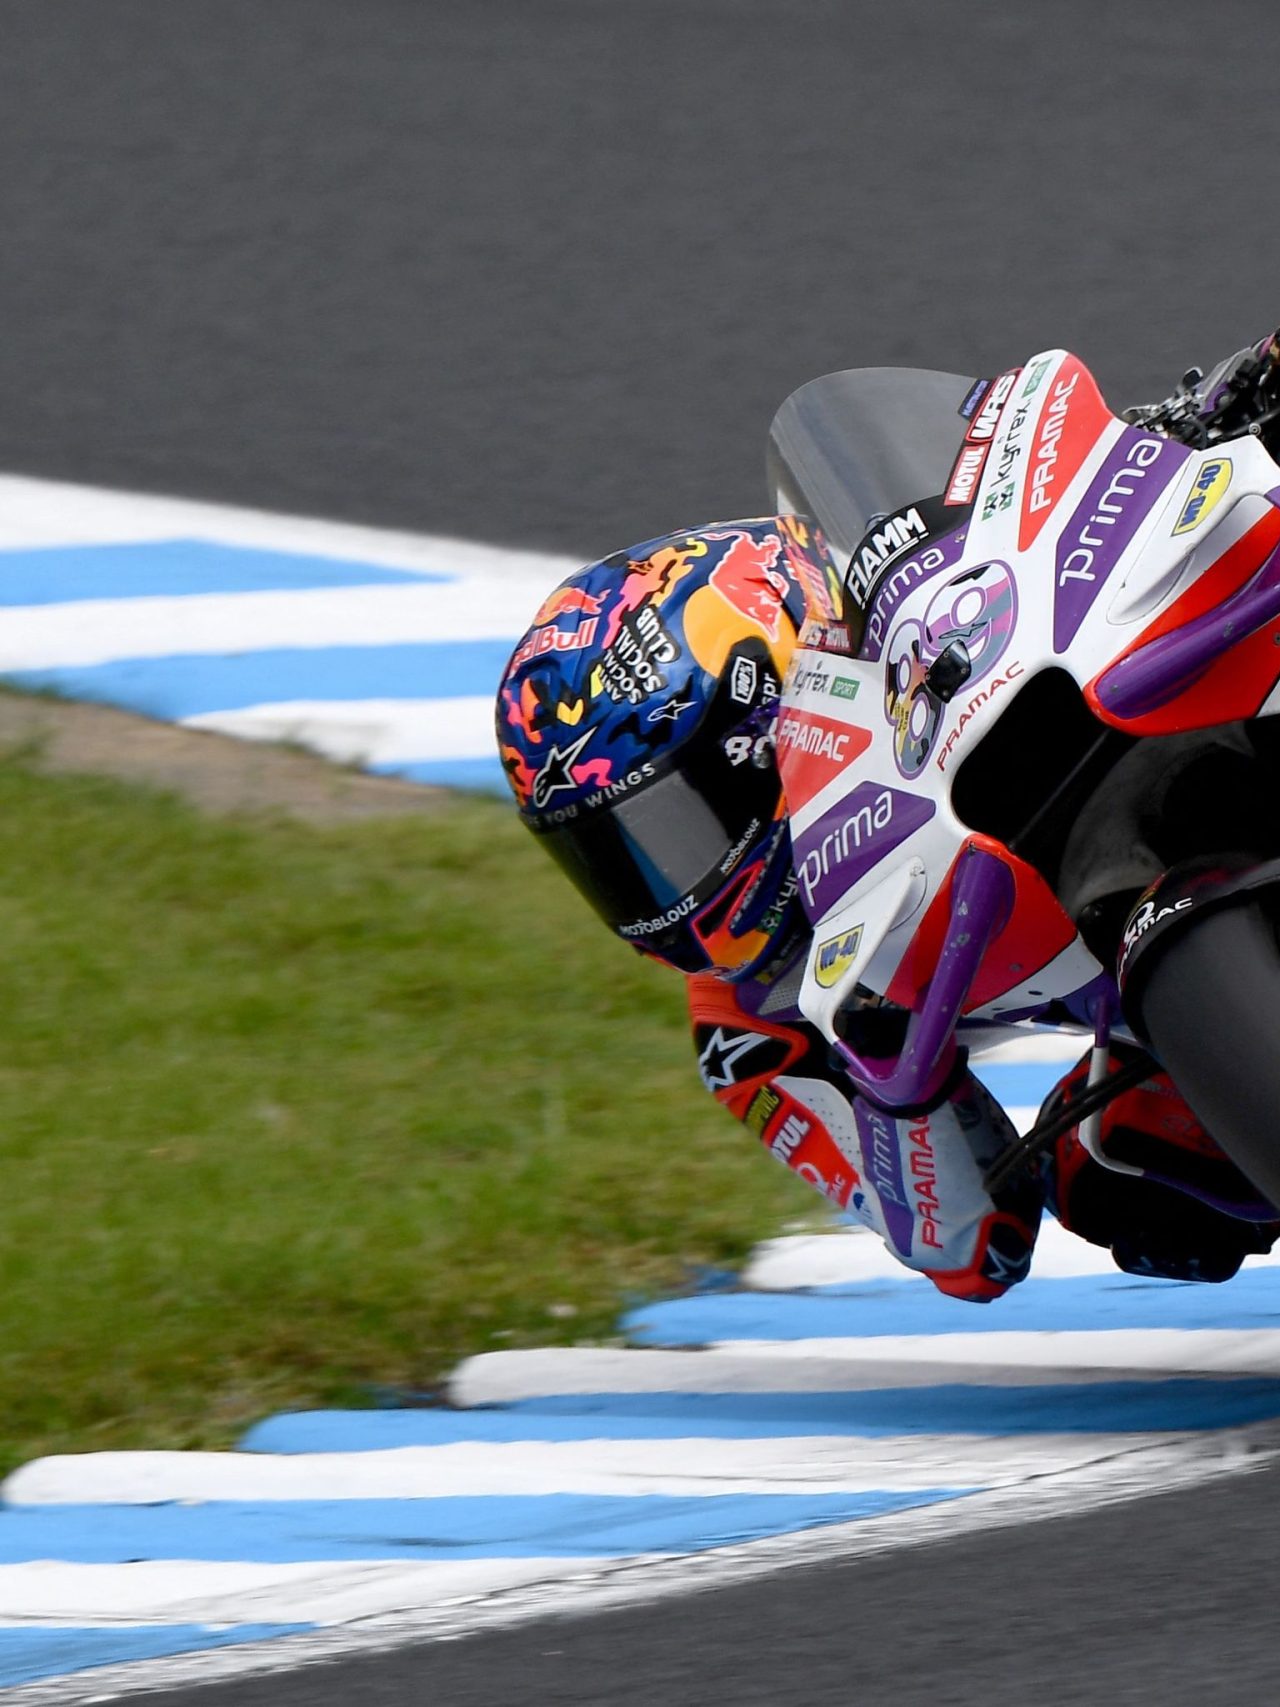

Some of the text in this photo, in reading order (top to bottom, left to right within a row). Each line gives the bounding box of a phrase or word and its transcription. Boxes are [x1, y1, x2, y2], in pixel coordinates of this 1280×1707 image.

[970, 374, 1016, 438] WRS
[949, 446, 985, 501] MOTUL
[1029, 372, 1080, 514] PRAMAC
[1059, 438, 1163, 587] prima
[1178, 464, 1222, 529] WD-40
[847, 507, 927, 606] FIAMM
[869, 548, 945, 647] prima
[537, 616, 599, 652] Bull
[615, 626, 661, 692] SOCIAL
[637, 607, 675, 663] CLUB
[603, 649, 642, 704] SOCIAL
[780, 719, 850, 762] PRAMAC
[936, 660, 1024, 772] PRAMAC
[585, 762, 656, 808] WINGS
[797, 790, 893, 907] prima
[620, 895, 698, 937] MOTOBLOUZ
